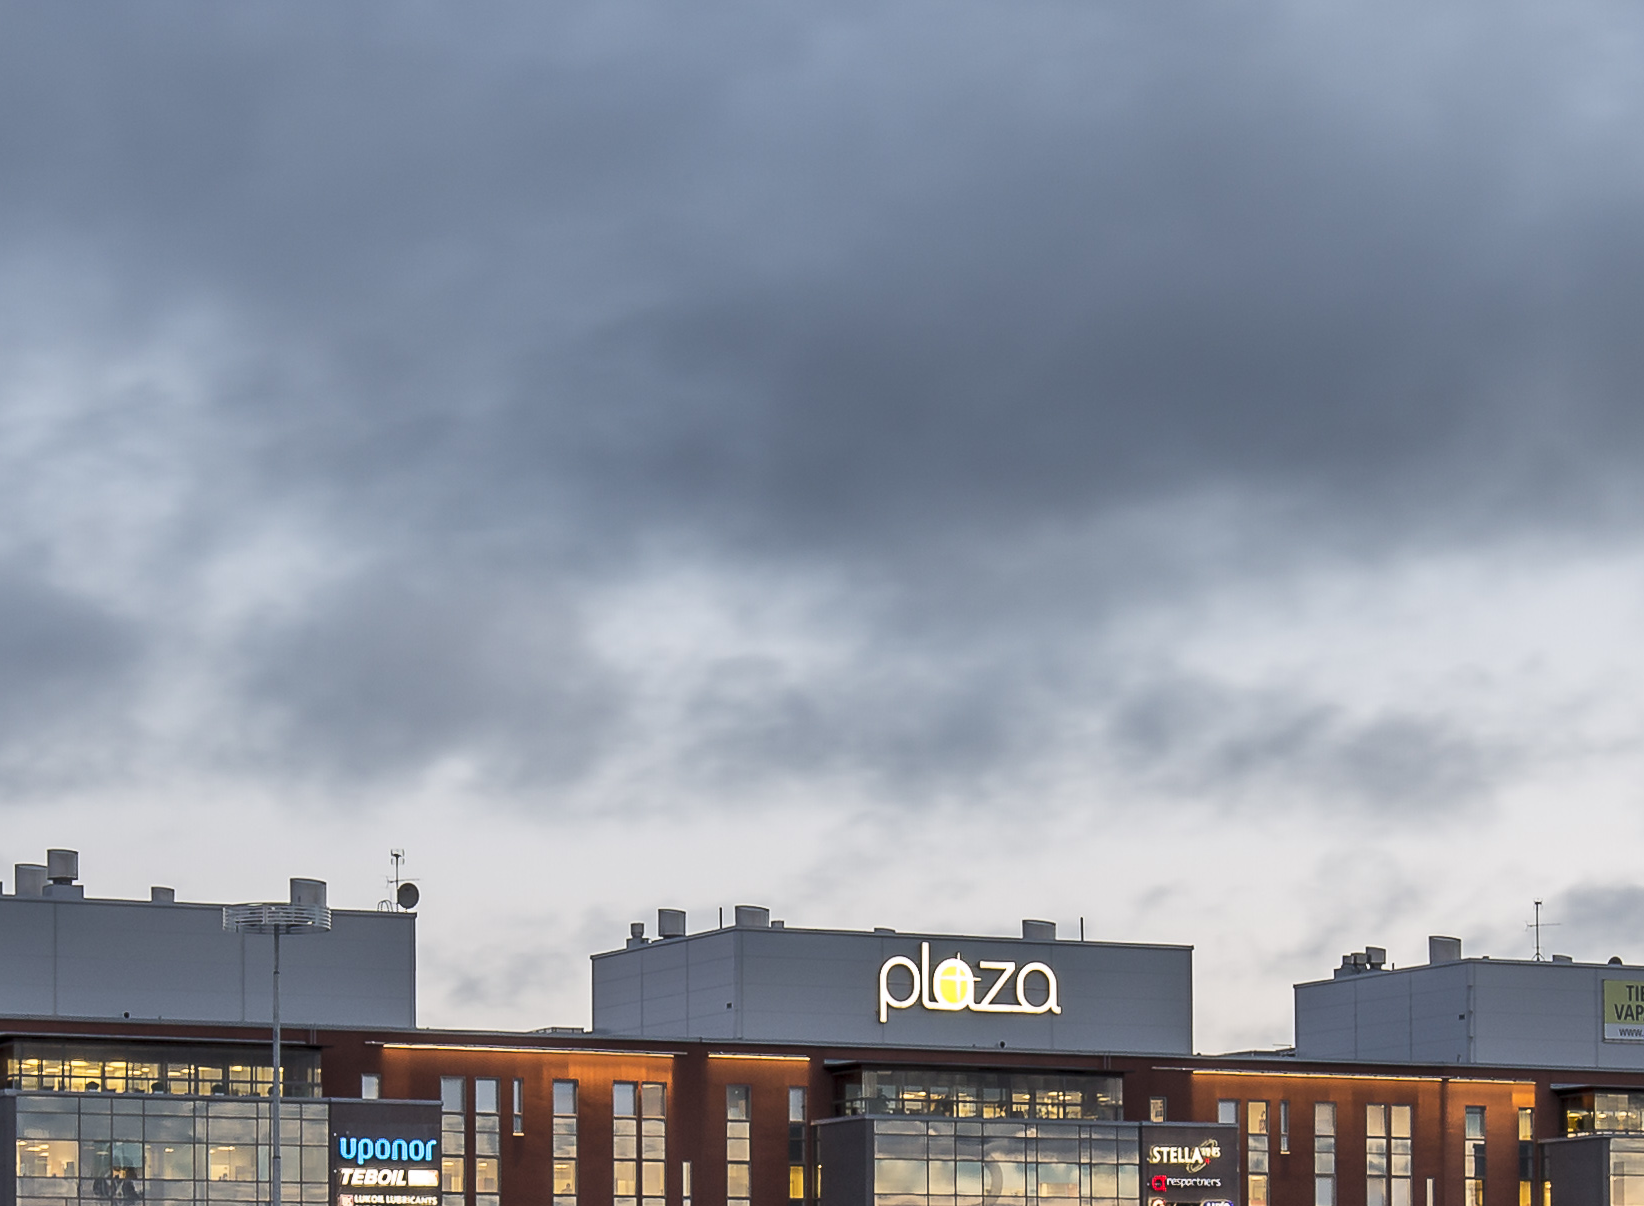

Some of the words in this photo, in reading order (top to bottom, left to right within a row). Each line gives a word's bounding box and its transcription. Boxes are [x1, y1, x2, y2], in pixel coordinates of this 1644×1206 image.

[879, 942, 1062, 1023] plaza
[339, 1137, 437, 1165] uponor
[1152, 1146, 1204, 1163] STELLA
[339, 1168, 407, 1187] TEBOIL
